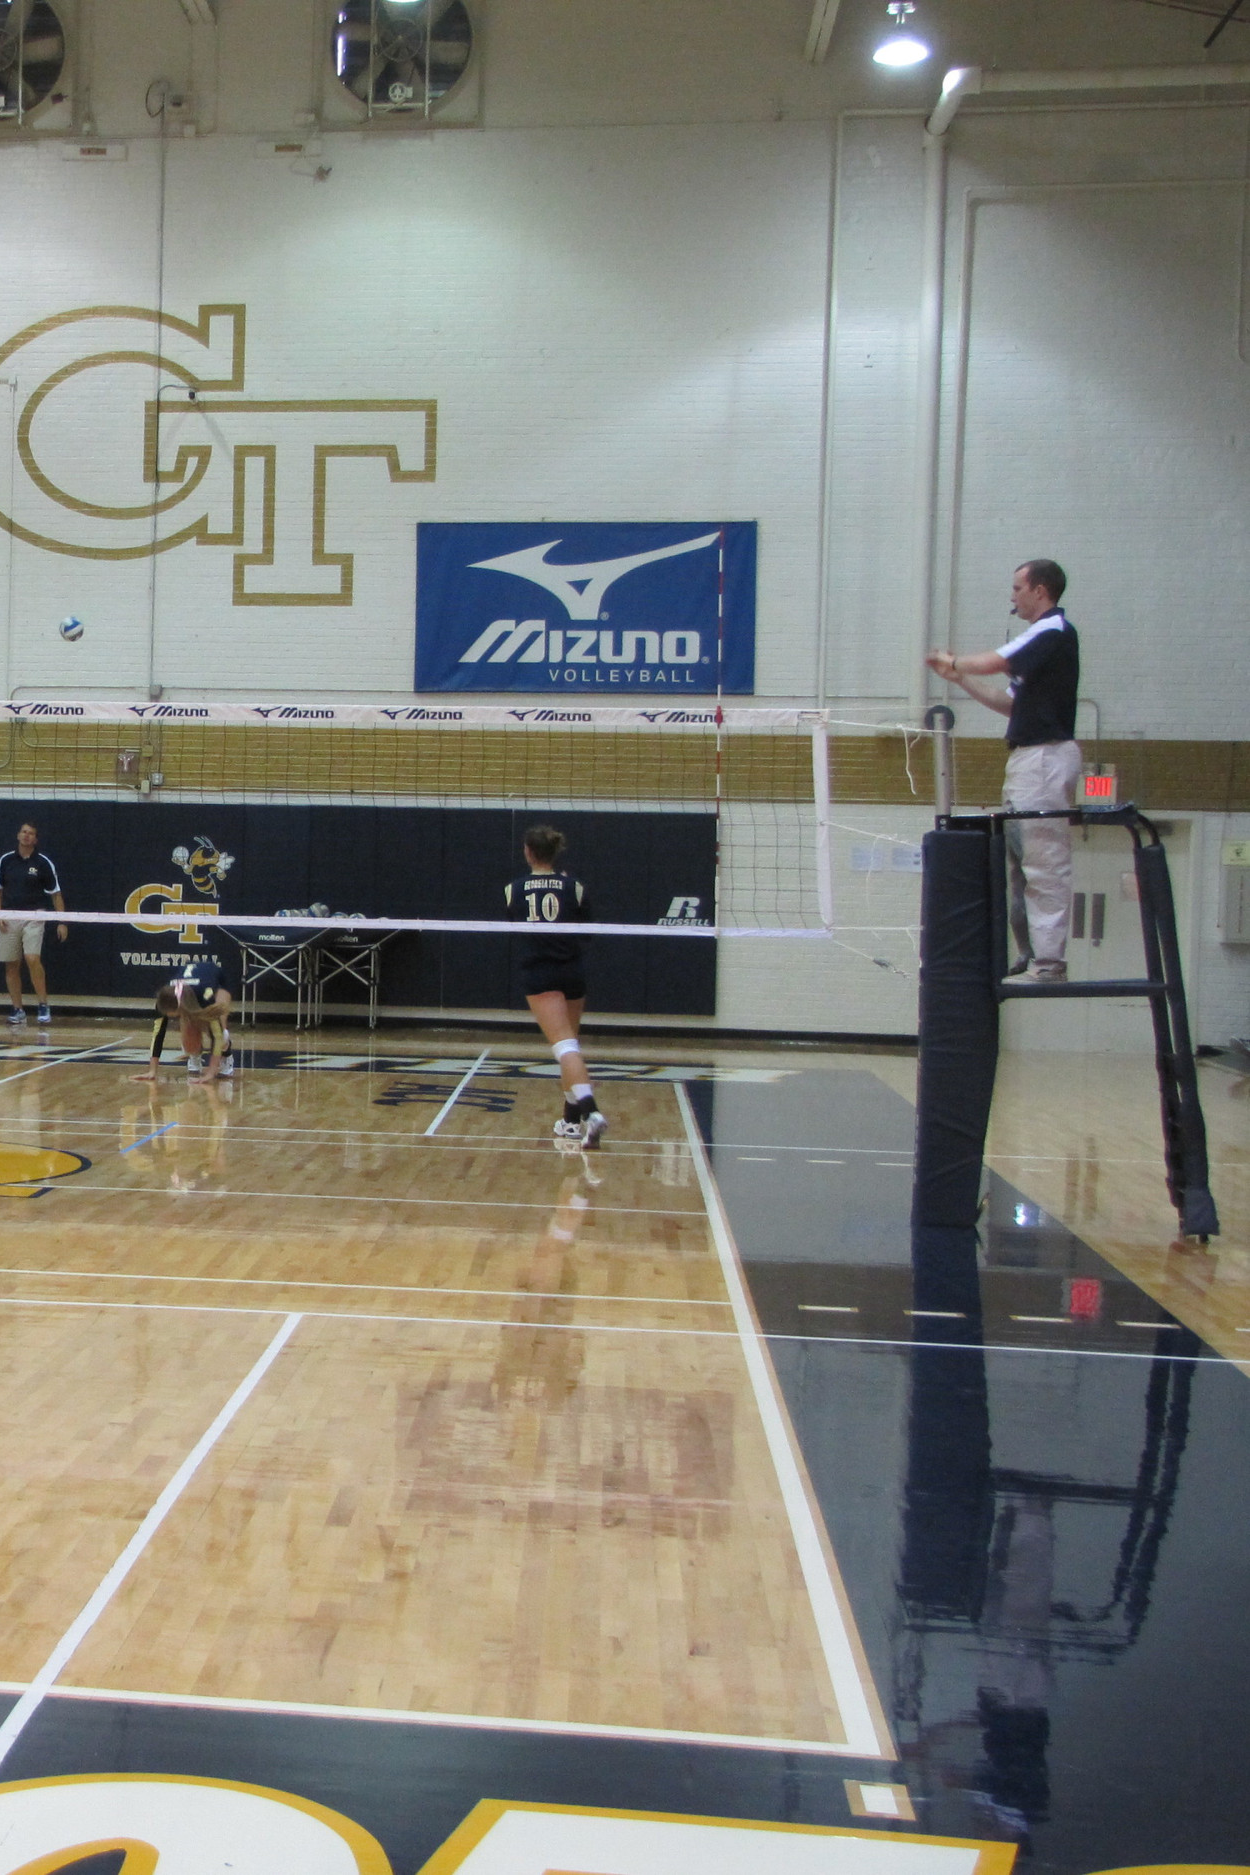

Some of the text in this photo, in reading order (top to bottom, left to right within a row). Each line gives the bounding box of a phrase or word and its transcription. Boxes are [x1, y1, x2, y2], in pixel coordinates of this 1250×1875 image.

[458, 619, 701, 664] MIZUNO
[549, 669, 695, 683] VOLLEYBALL
[665, 711, 720, 723] MIZUN
[1085, 776, 1112, 797] EXIT
[525, 893, 559, 922] 10
